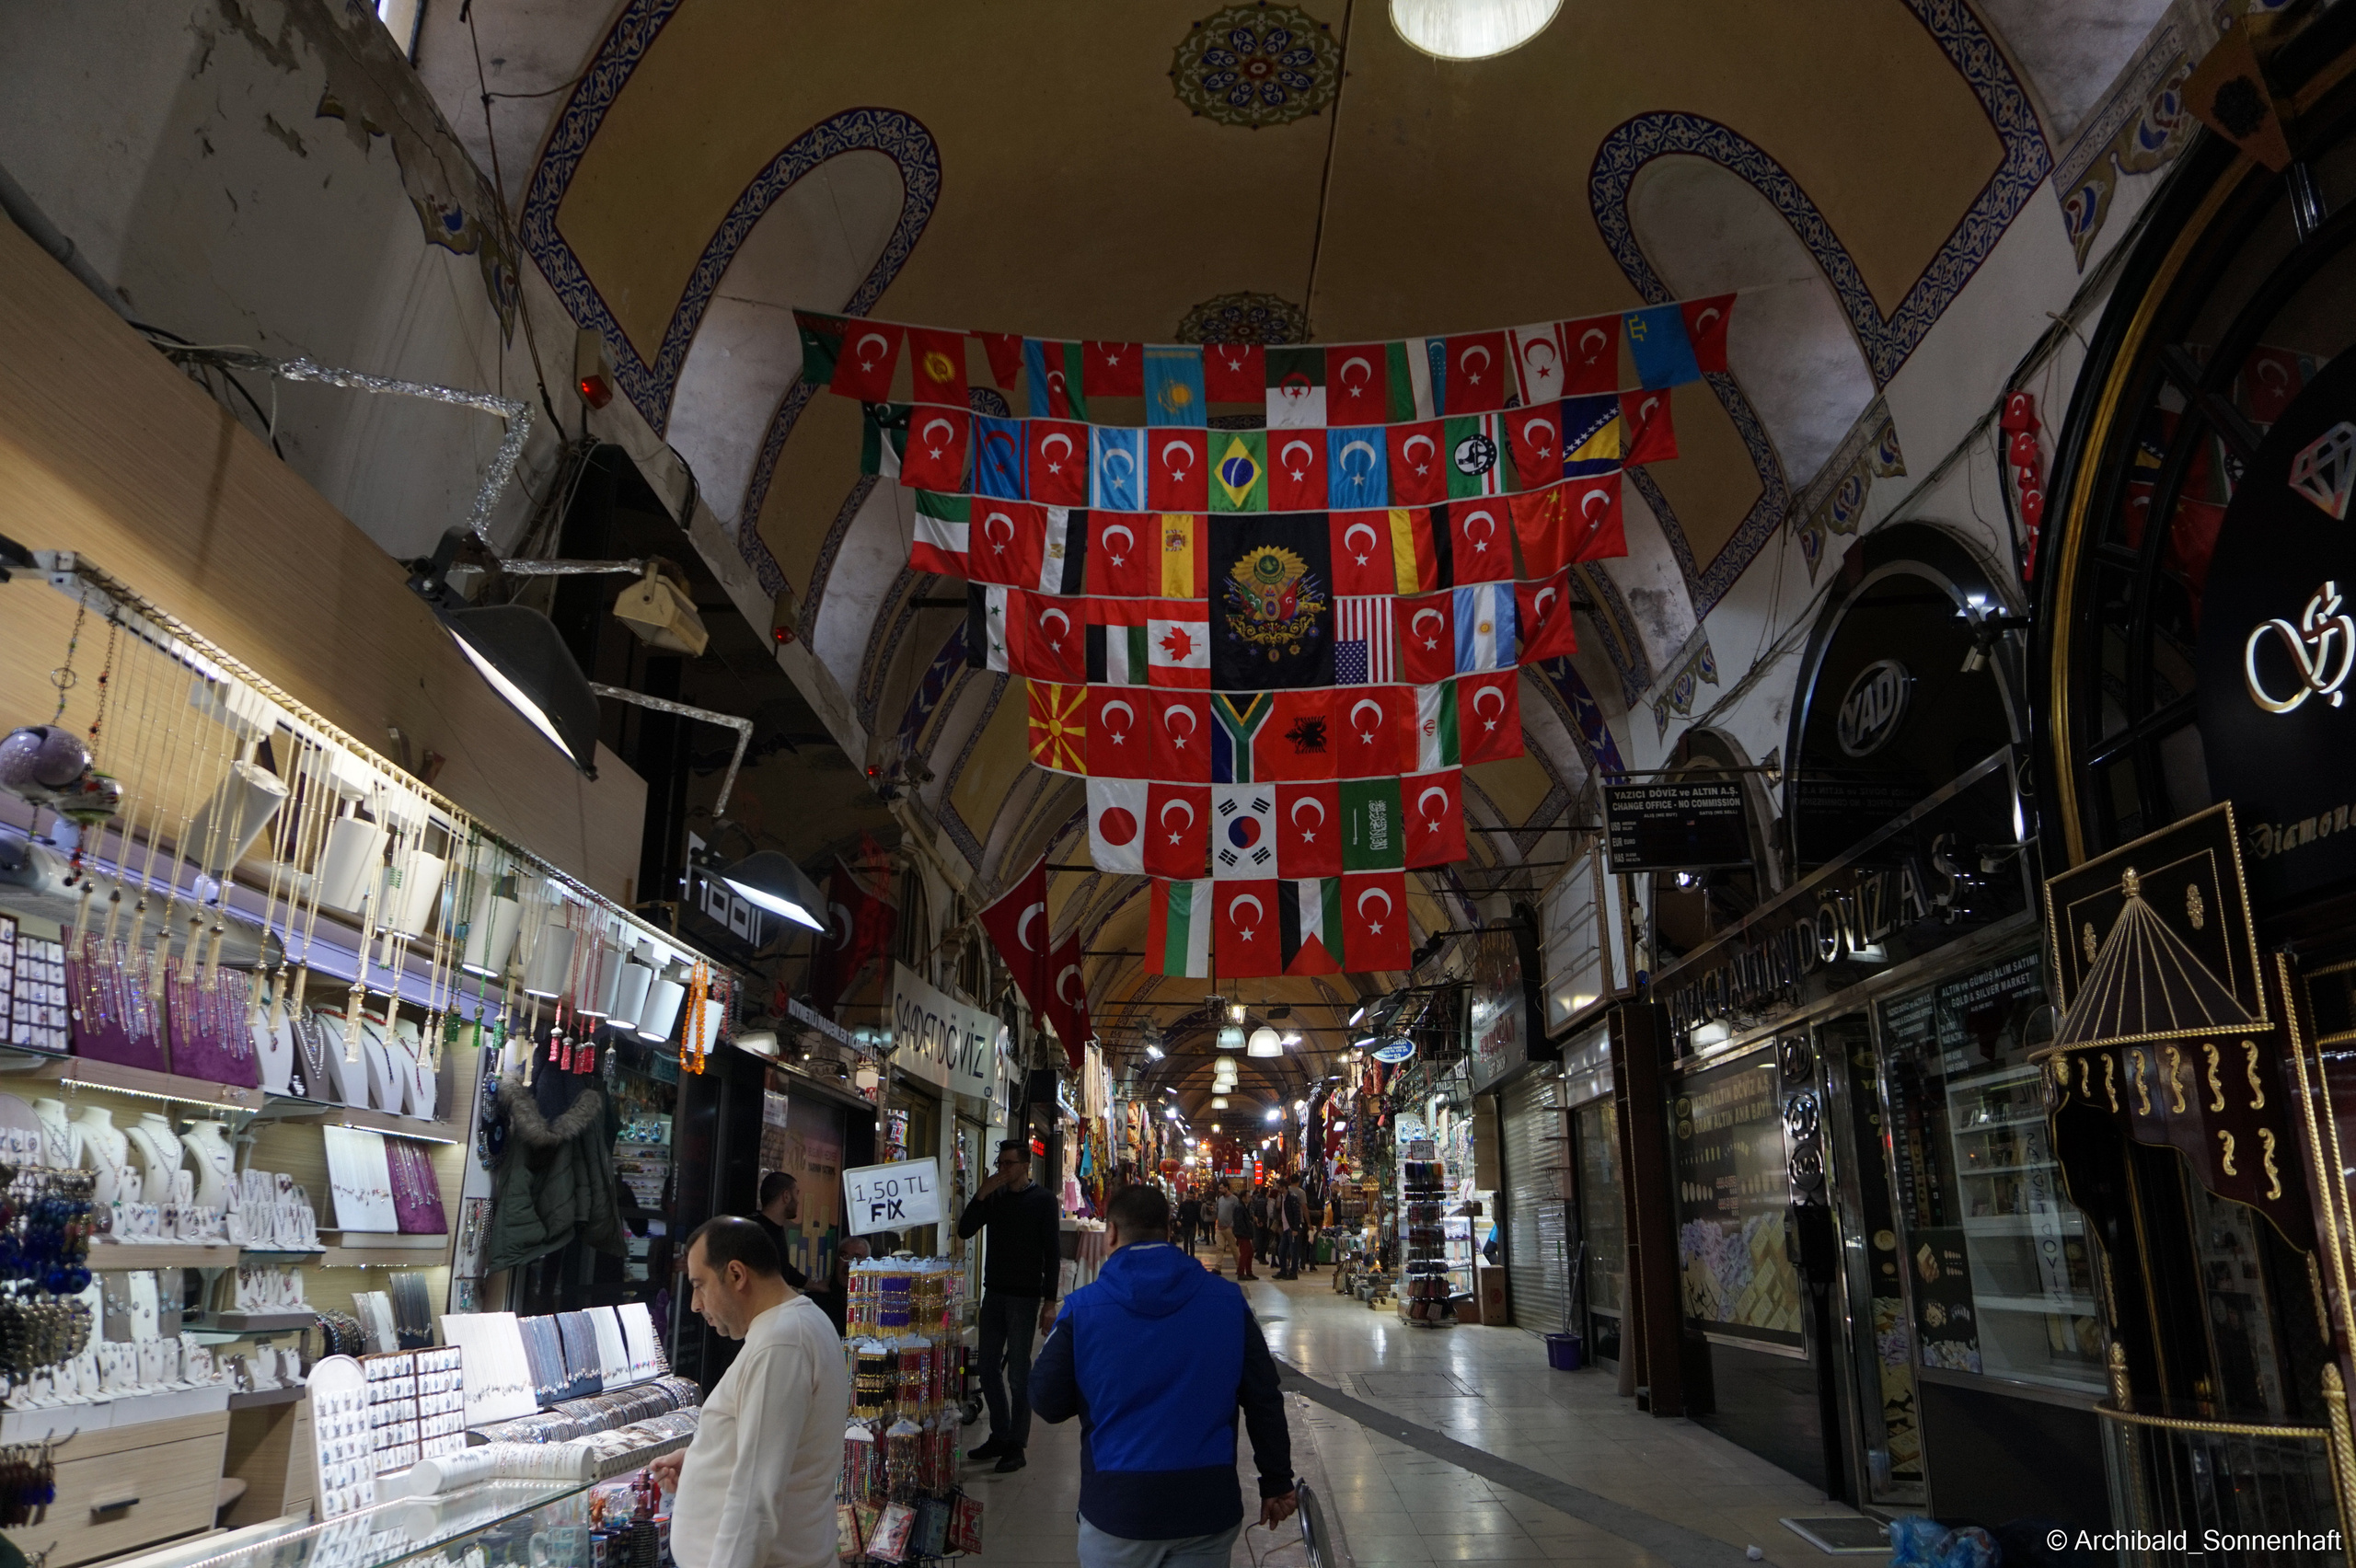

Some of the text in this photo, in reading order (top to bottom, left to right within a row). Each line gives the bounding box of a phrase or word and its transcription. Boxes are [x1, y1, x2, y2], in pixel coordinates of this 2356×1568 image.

[1842, 671, 1897, 747] YAD
[1612, 801, 1644, 811] CHANGE
[1646, 800, 1672, 810] OFFICE
[1679, 800, 1690, 809] NO
[1692, 798, 1741, 808] COMMISSION
[1614, 790, 1646, 800] YAZICI
[1649, 787, 1677, 798] DÖVİZ
[1692, 787, 1718, 797] ALTIN
[1721, 786, 1738, 797] A.Ş.
[1611, 822, 1621, 831] USD
[1612, 837, 1623, 847] EUR
[1614, 853, 1624, 863] HAS
[1796, 868, 1891, 976] DÖVİZ
[1942, 953, 2038, 997] ALTIN ve GÜMÜŞ ALIM SATIMI
[1951, 995, 1969, 1008] GOLD
[1976, 984, 2000, 999] SILVER
[2001, 972, 2030, 992] MARKET
[895, 993, 985, 1078] SAADET DÖVİZ
[855, 1176, 929, 1204] 1,50 TL
